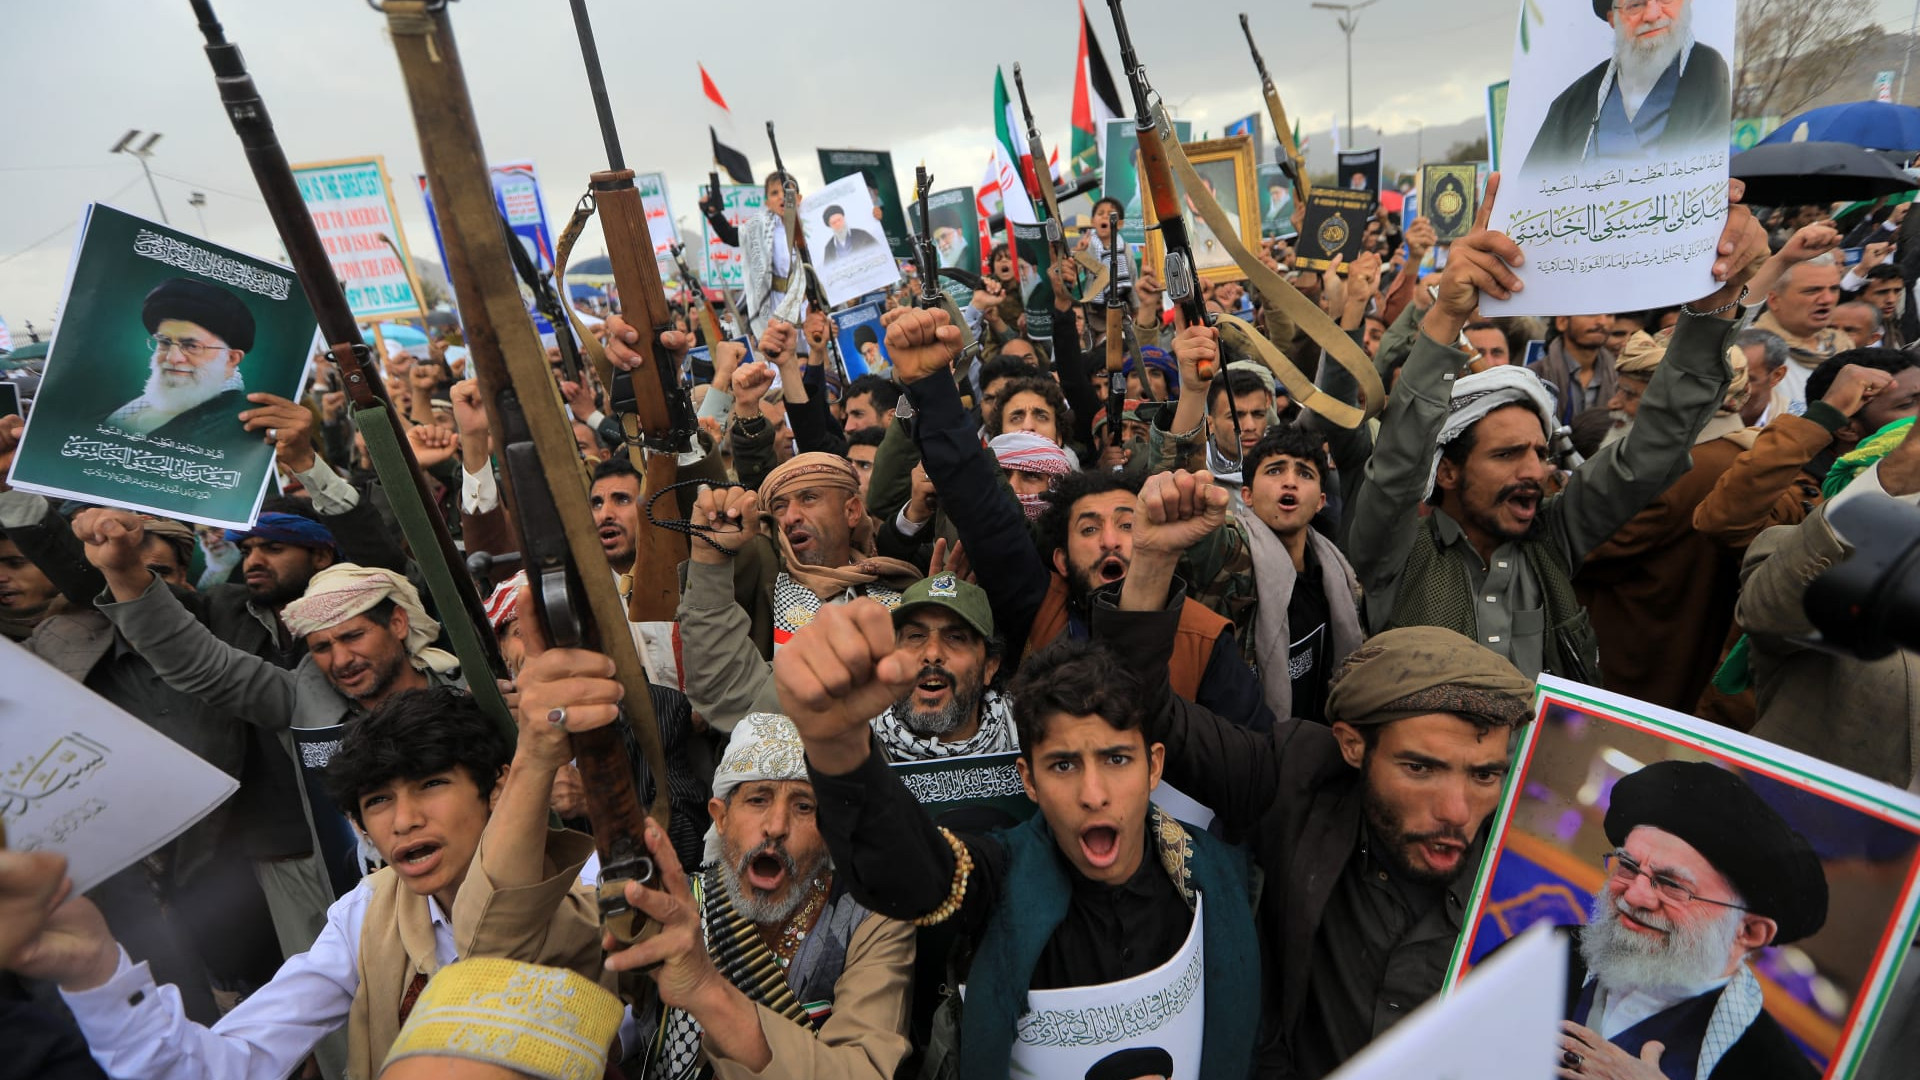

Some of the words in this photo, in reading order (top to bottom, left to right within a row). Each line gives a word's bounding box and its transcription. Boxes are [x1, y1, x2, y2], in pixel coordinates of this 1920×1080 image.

[346, 206, 389, 227] AMERICA
[1588, 194, 1668, 243] الحسيني
[381, 283, 412, 305] ISLAM
[195, 465, 241, 489] السيد
